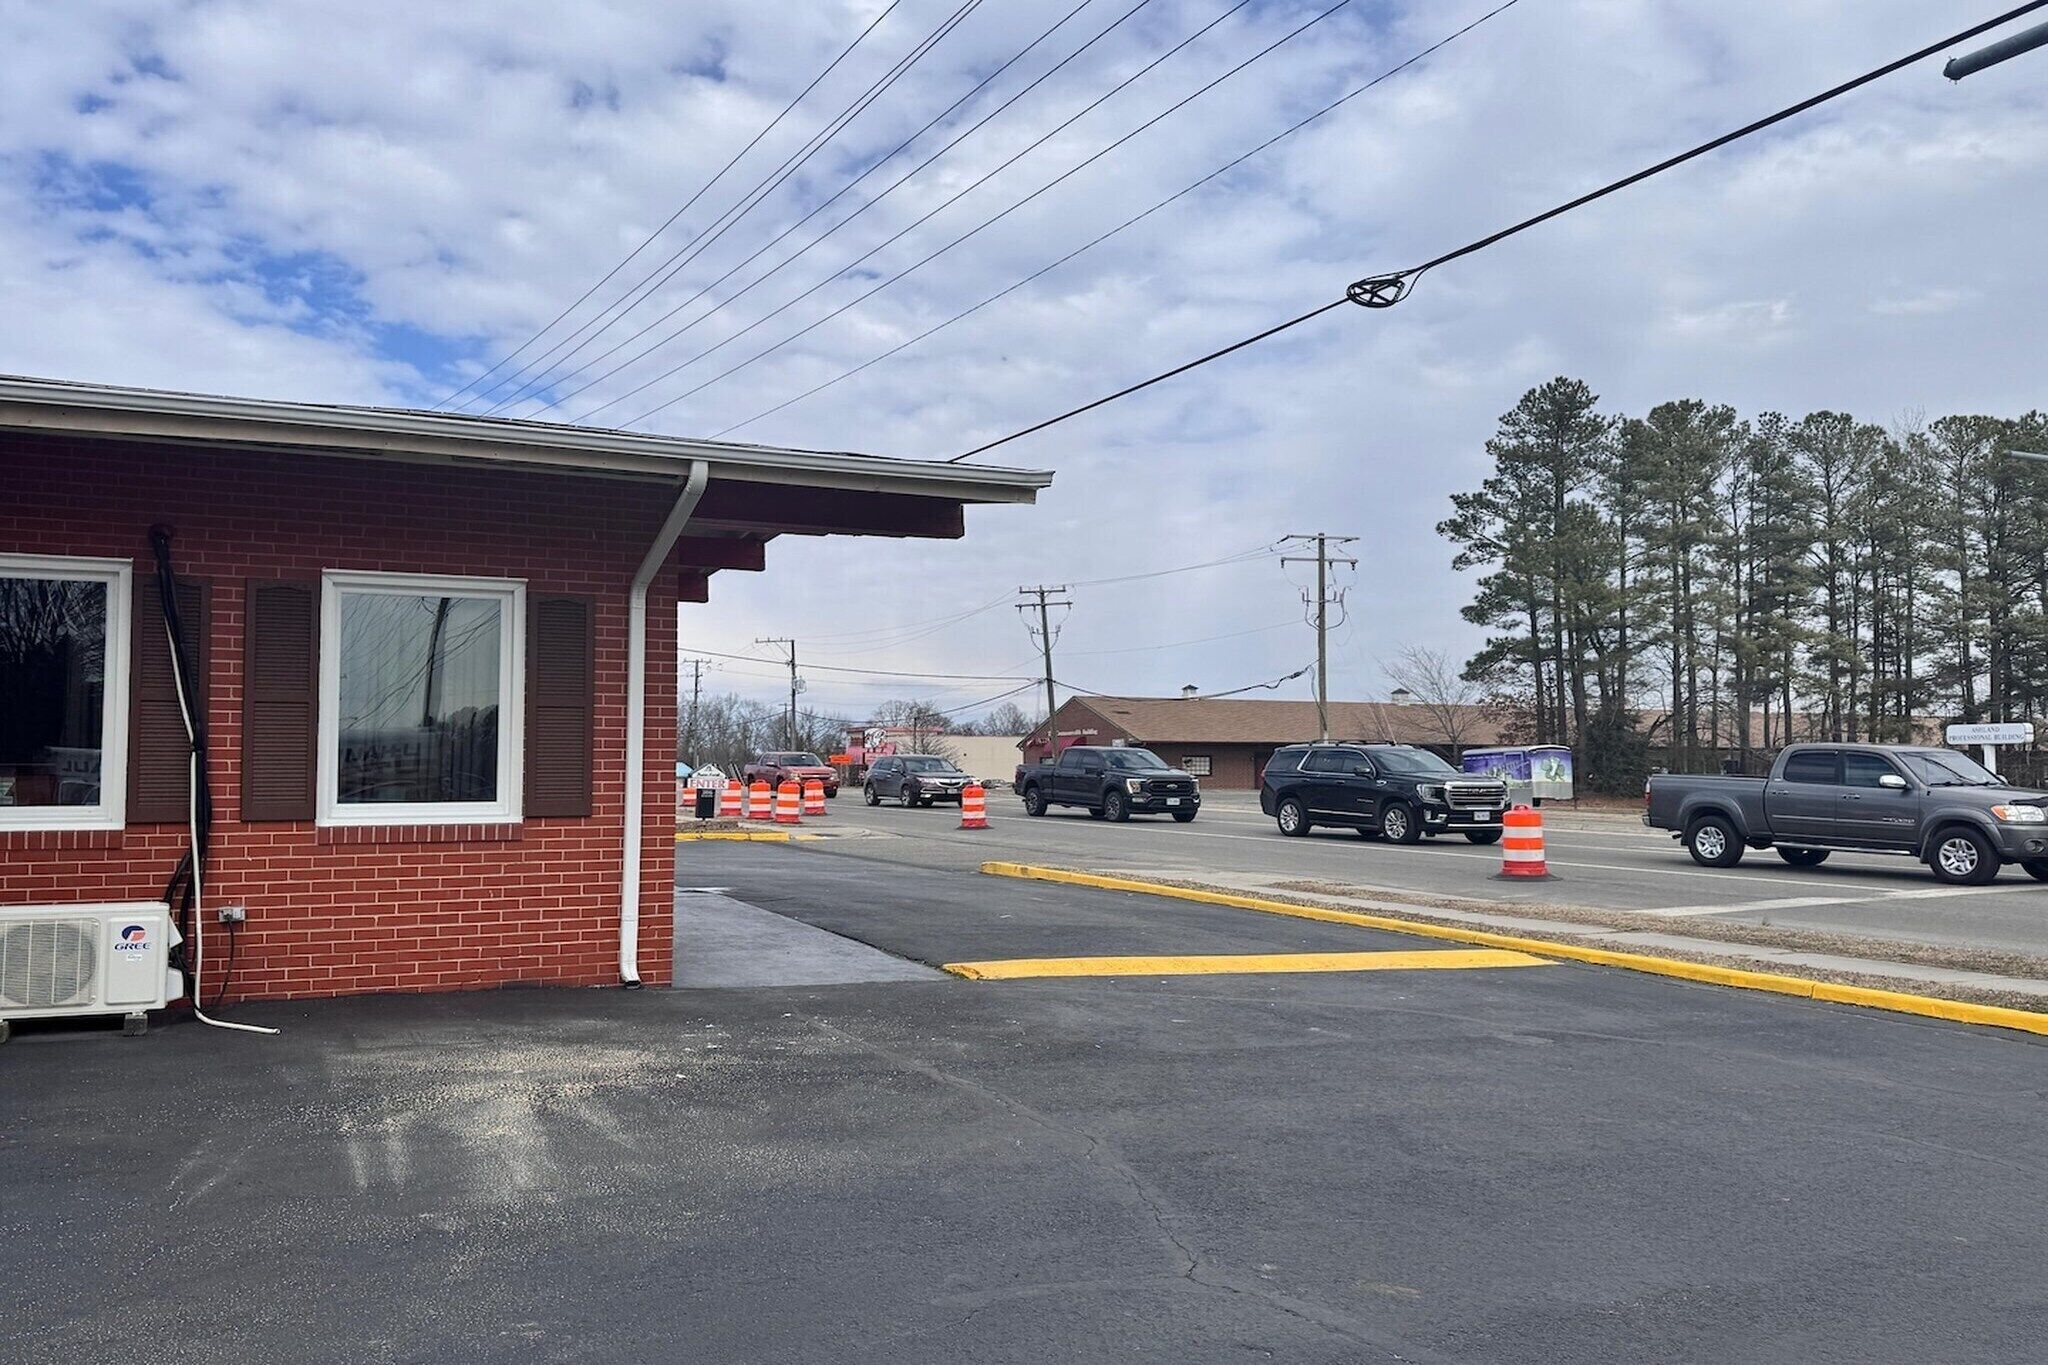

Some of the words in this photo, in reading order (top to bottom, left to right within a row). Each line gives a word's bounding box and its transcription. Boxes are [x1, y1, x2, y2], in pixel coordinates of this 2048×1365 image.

[1949, 734, 1992, 742] PROFESSIONAL
[1993, 733, 2025, 741] BUILDING
[690, 779, 726, 789] ENTER
[114, 943, 152, 951] GREE
